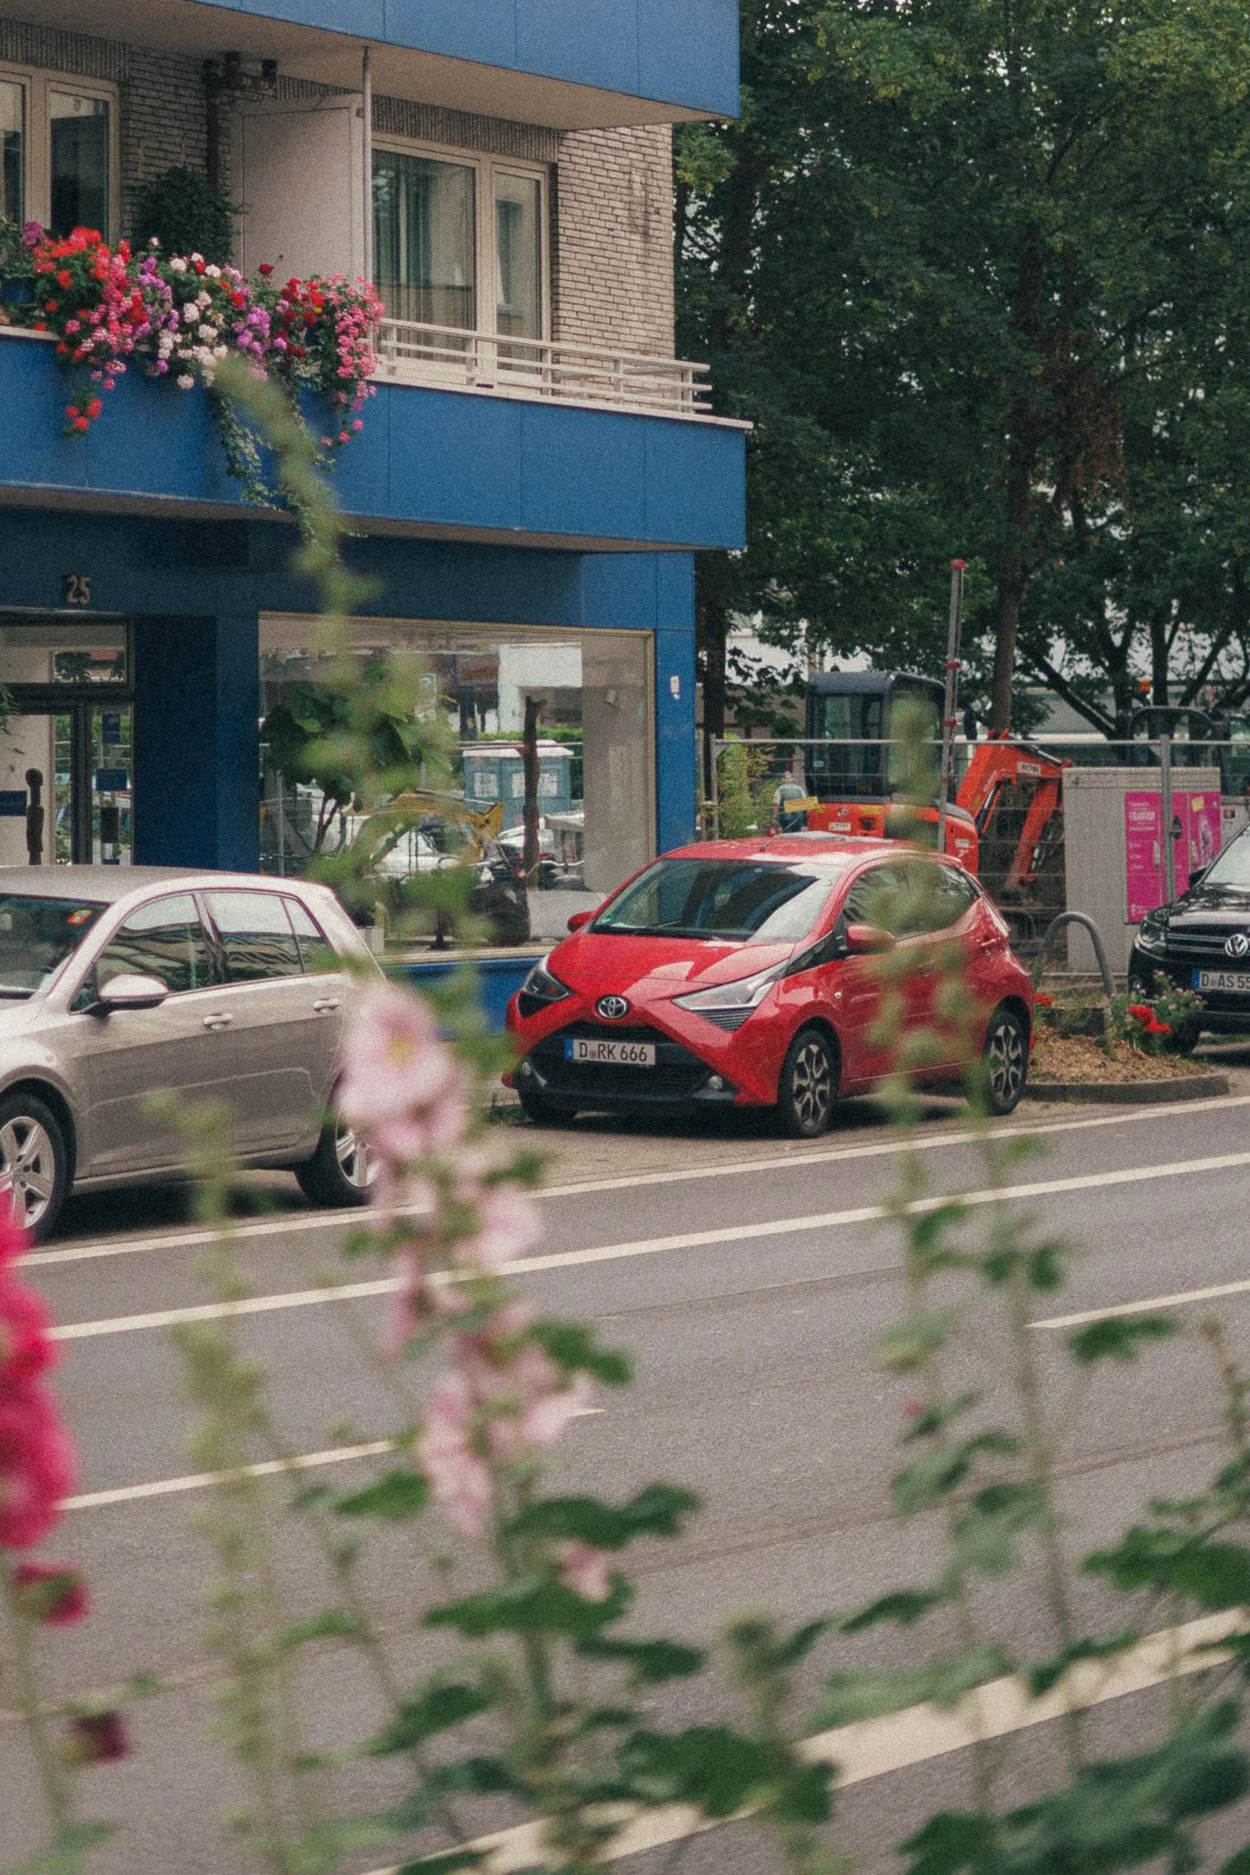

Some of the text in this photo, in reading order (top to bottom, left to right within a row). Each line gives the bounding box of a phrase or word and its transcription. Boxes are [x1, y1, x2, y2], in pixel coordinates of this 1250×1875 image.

[67, 574, 91, 605] 25
[1201, 973, 1210, 987] D
[1217, 974, 1235, 989] AS
[579, 1041, 648, 1063] D RK 666
